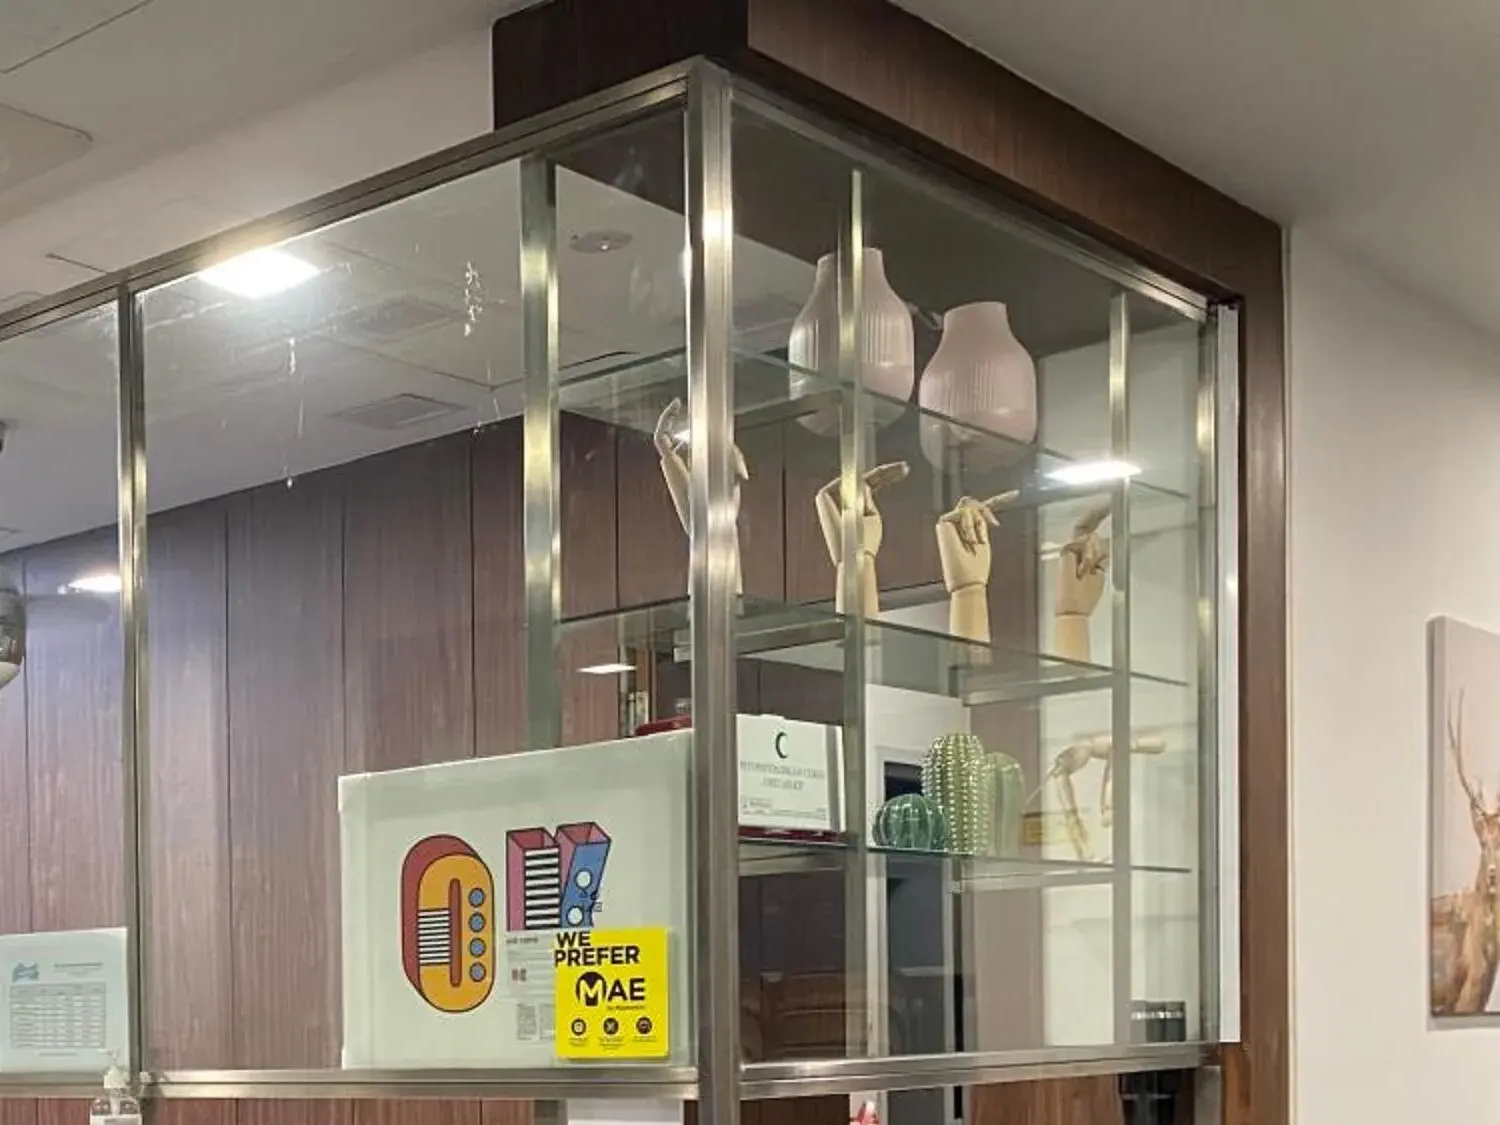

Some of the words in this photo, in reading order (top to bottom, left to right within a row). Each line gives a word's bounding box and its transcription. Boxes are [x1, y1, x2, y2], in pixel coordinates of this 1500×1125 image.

[557, 931, 591, 947] WE
[554, 945, 640, 967] PREFER
[576, 971, 645, 1006] MAE
